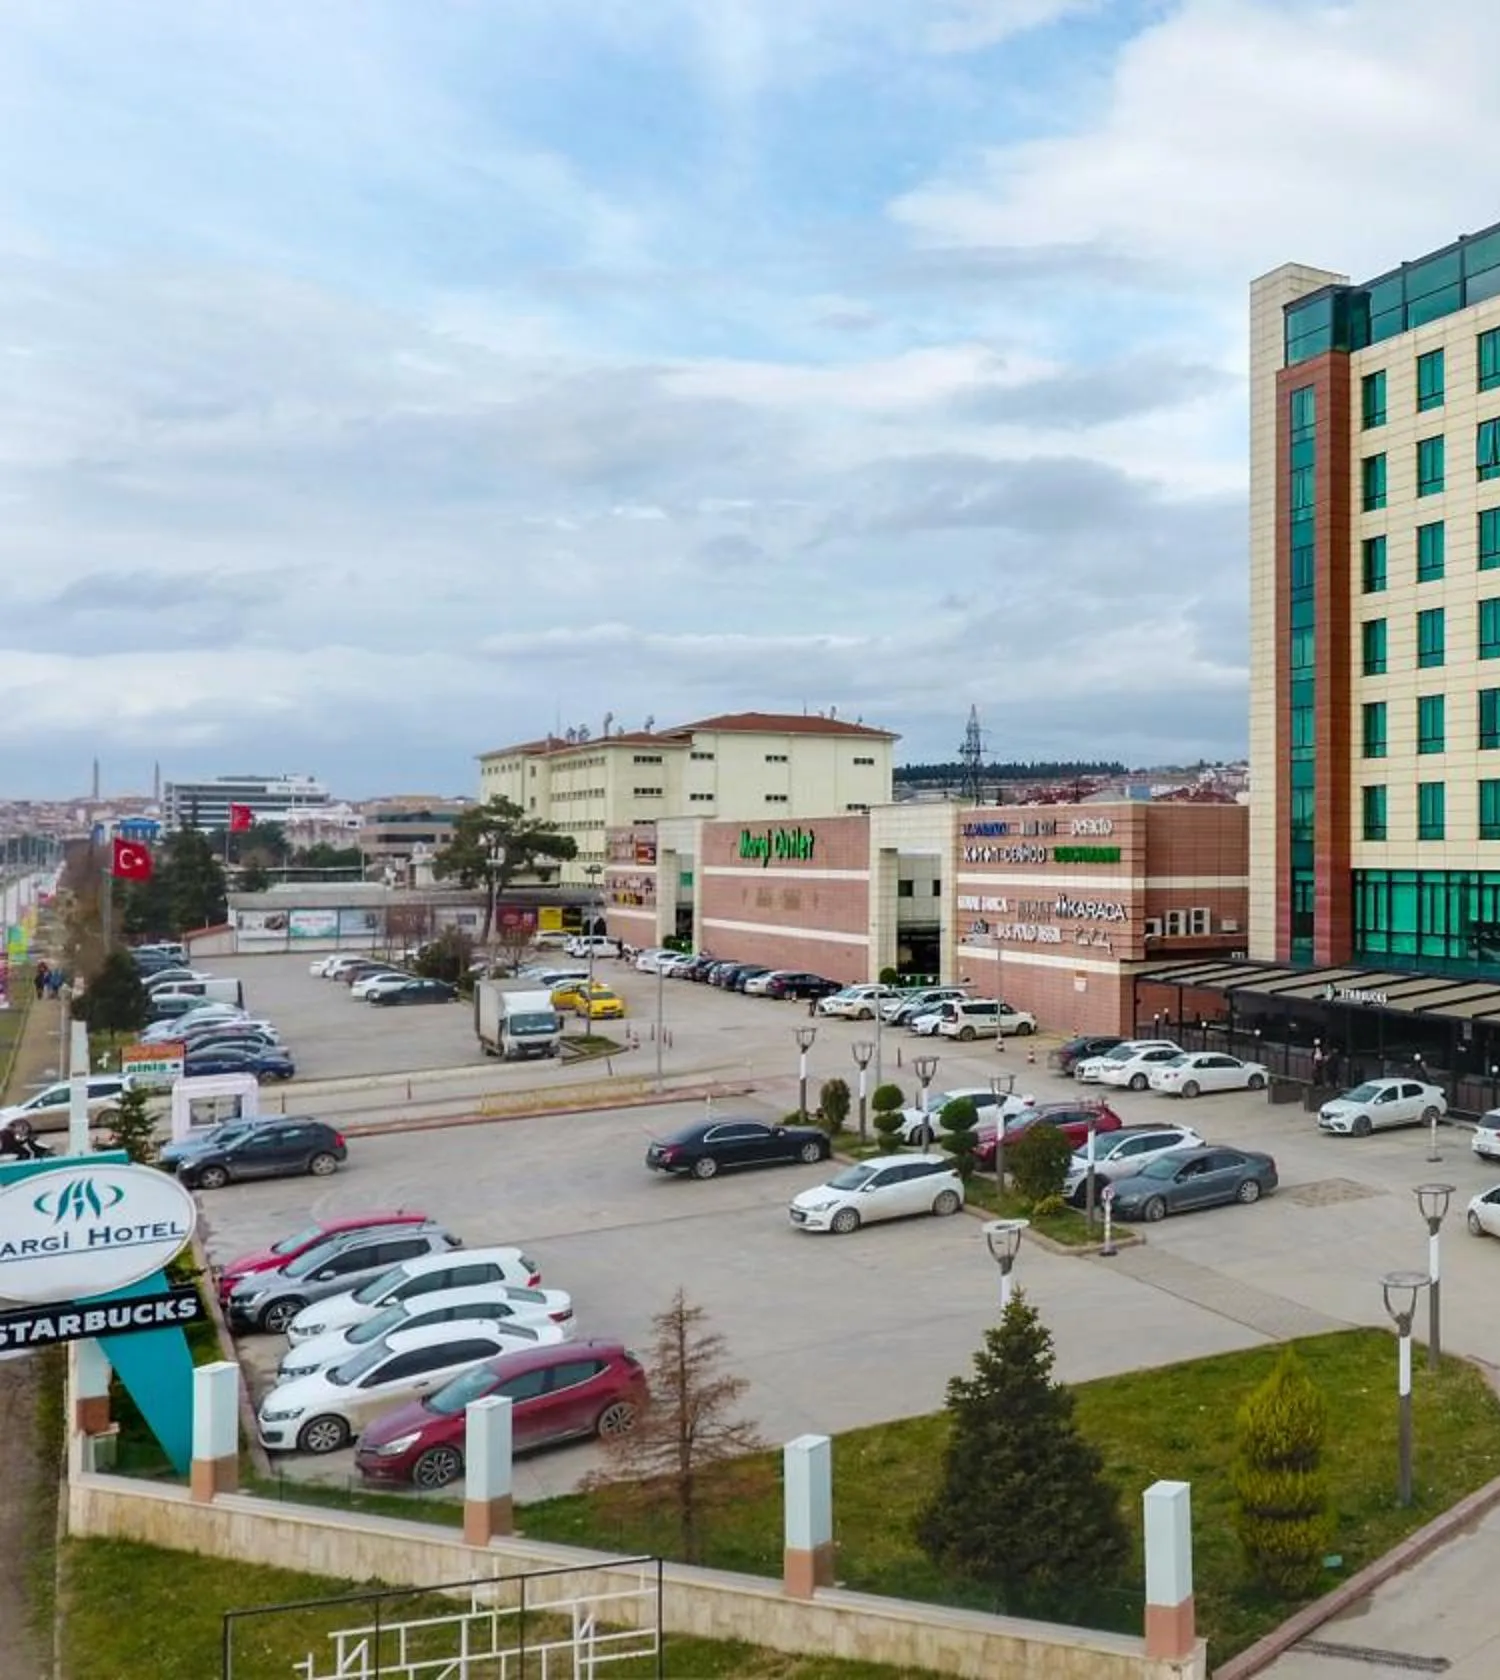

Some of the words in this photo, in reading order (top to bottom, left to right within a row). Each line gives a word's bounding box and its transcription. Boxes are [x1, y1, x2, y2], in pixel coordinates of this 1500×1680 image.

[1067, 898, 1128, 922] KARACA
[0, 1231, 69, 1256] ARGİ
[88, 1221, 187, 1246] HOTEL
